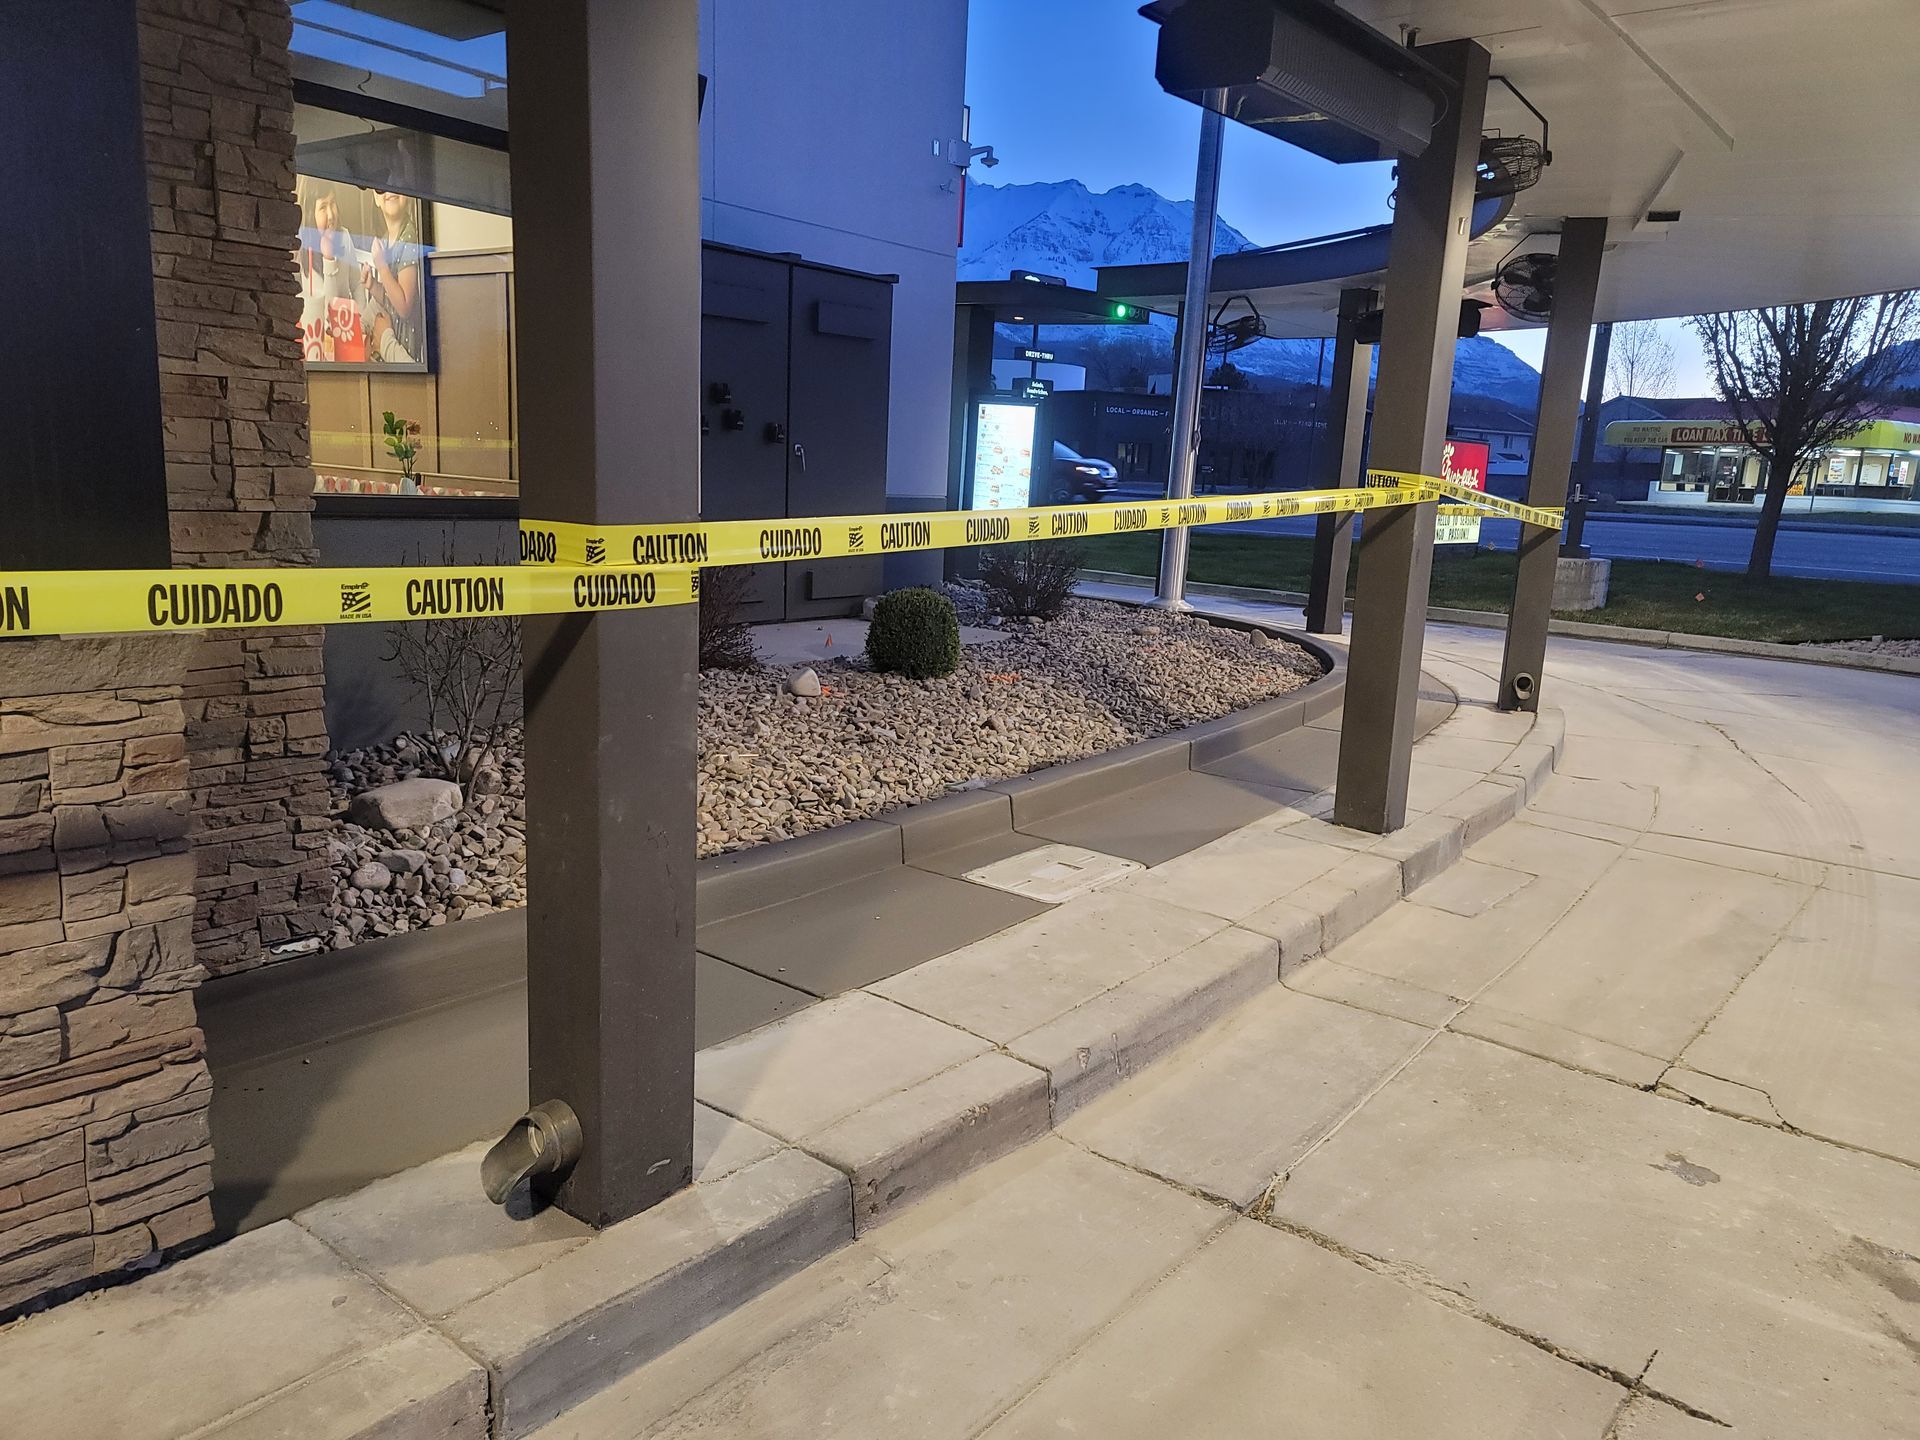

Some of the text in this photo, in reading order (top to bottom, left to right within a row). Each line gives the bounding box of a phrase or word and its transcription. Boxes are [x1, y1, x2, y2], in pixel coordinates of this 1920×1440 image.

[1676, 428, 1704, 442] LOAN
[1705, 428, 1728, 442] MAX
[1732, 428, 1758, 442] TIE
[632, 532, 708, 566] CAUTION
[760, 527, 822, 559] CUIDADO
[880, 520, 930, 550] CAUTION
[966, 516, 1010, 543] CUIDADO
[1051, 510, 1088, 536] CAUTION
[1113, 507, 1147, 531] CUIDADO
[1178, 503, 1207, 525] CAUTION
[1226, 501, 1253, 521] CUIDADO
[147, 583, 283, 626] CUIDADO
[406, 577, 504, 616] CAUTION
[573, 572, 656, 608] CUIDADO
